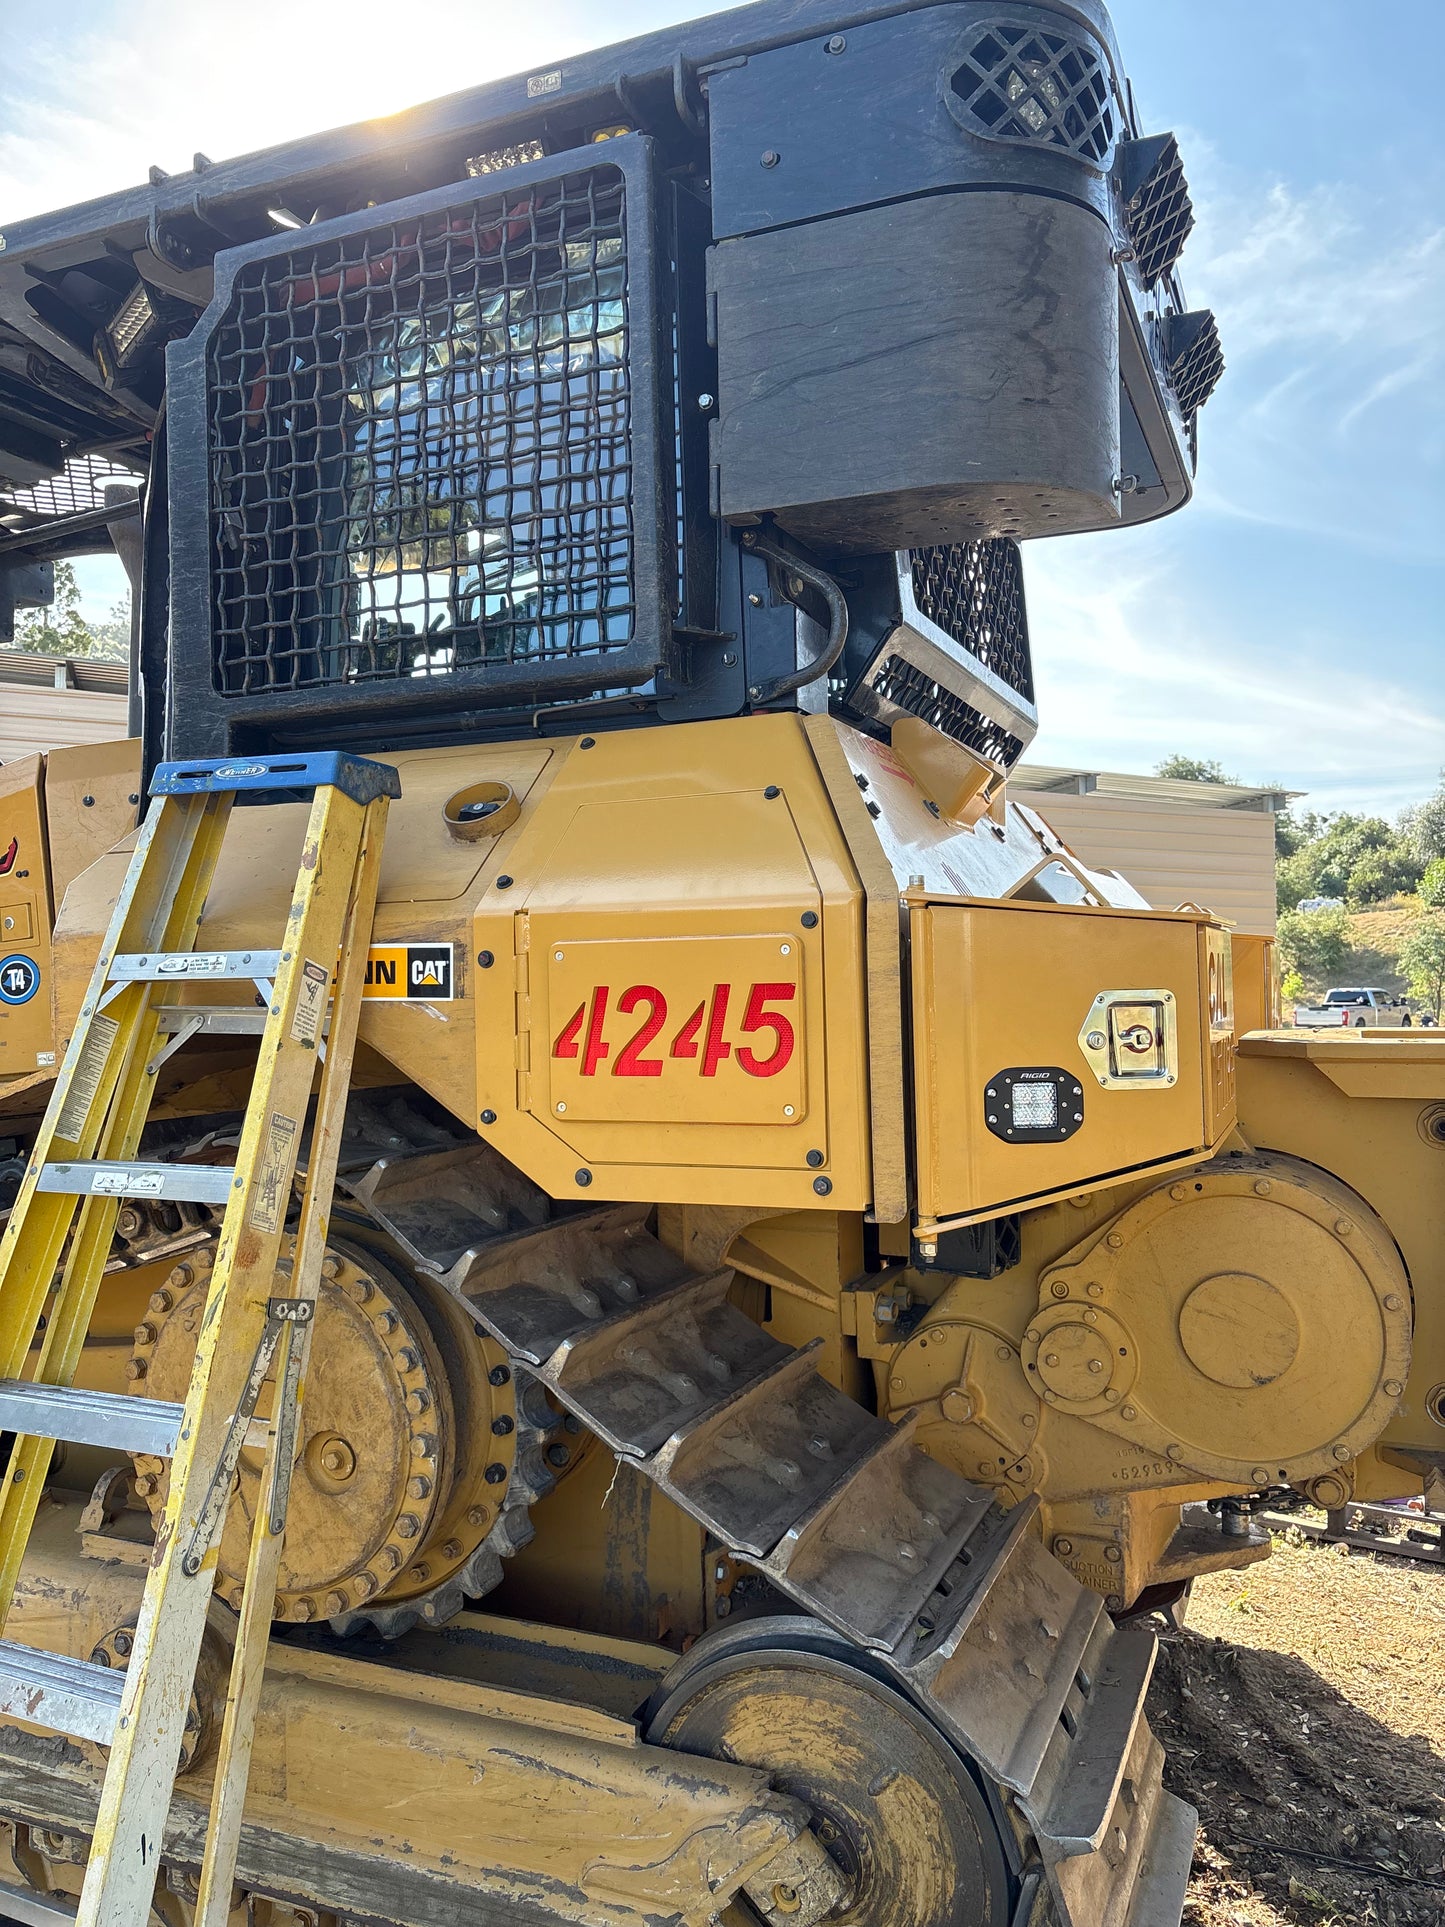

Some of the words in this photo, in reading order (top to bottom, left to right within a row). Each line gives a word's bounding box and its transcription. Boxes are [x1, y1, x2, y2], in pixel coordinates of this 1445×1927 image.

[7, 969, 25, 991] T4
[411, 960, 449, 985] CAT
[551, 982, 797, 1078] 4245
[1062, 1559, 1113, 1576] SUCTION
